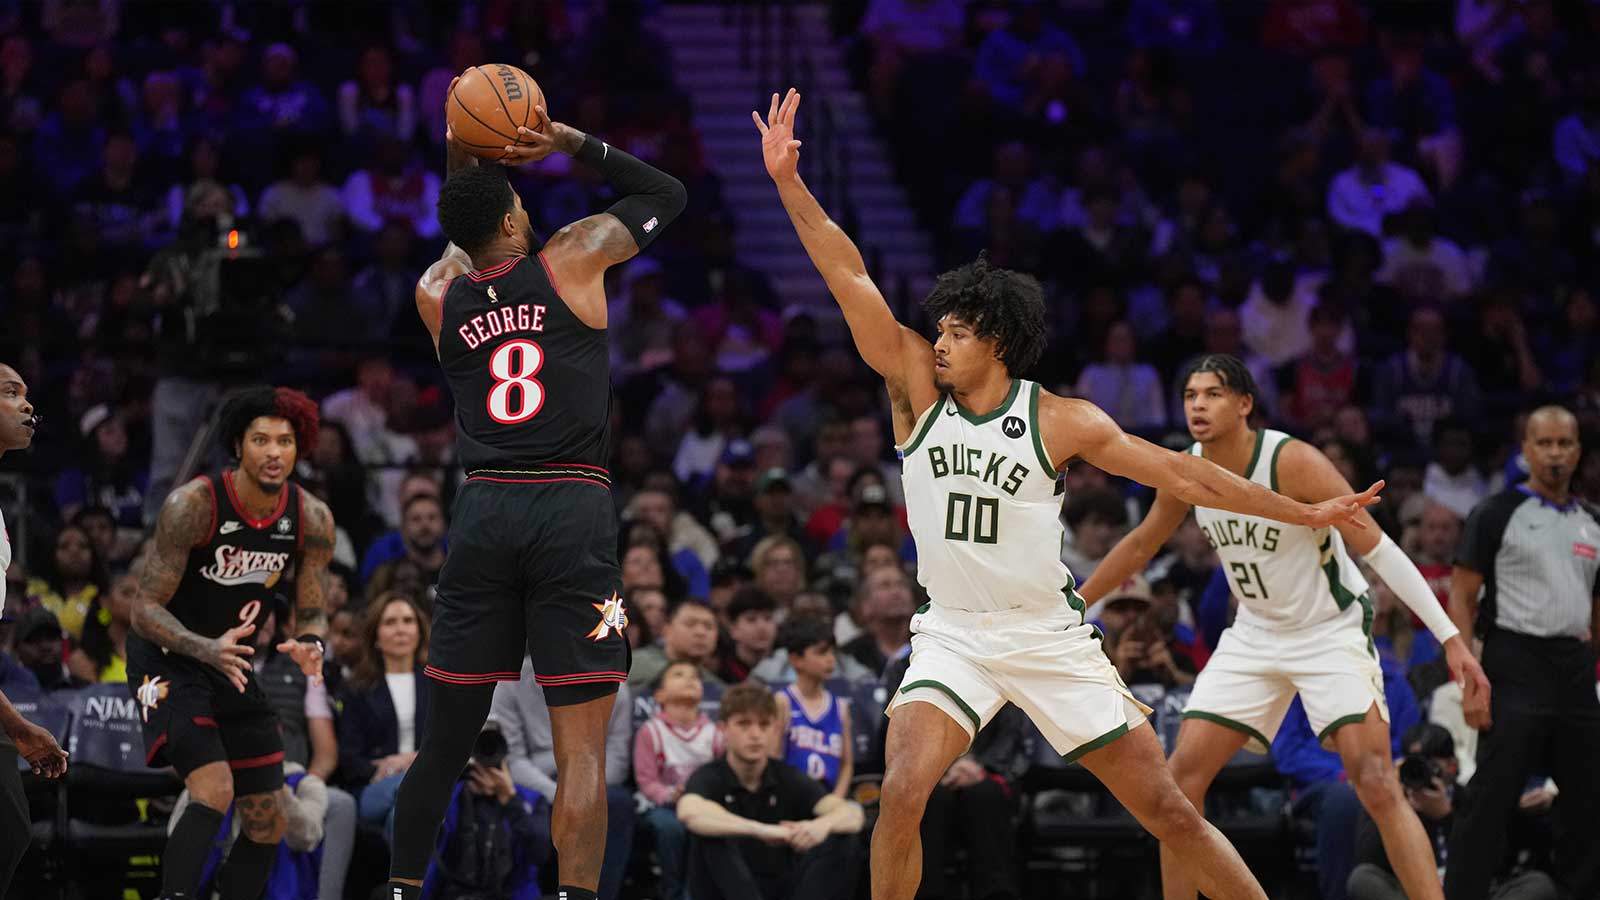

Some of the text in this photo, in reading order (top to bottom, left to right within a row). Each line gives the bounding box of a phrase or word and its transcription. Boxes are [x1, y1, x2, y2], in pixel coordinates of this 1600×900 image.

[458, 304, 547, 349] GEORGE
[486, 338, 545, 425] 8
[928, 444, 1030, 496] BUCKS
[945, 492, 999, 544] 00
[1202, 519, 1281, 552] BUCKS
[1231, 562, 1269, 599] 21
[239, 600, 261, 628] 9
